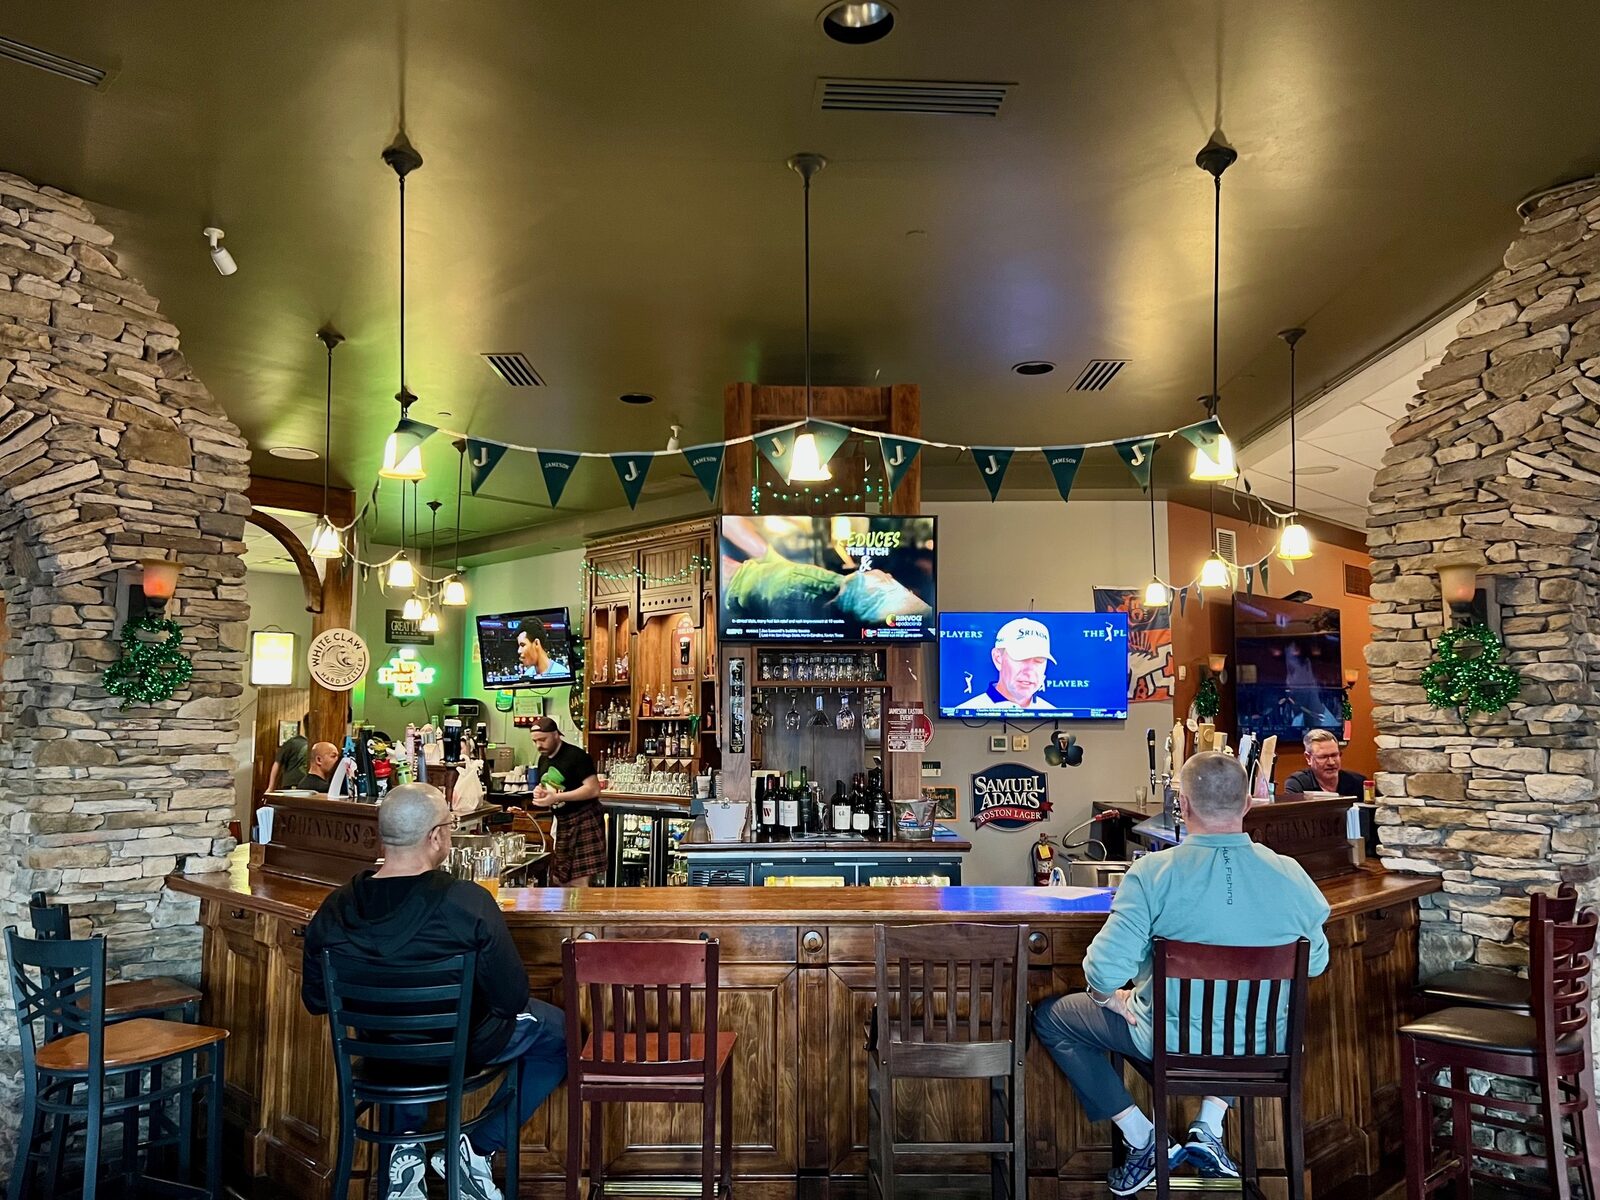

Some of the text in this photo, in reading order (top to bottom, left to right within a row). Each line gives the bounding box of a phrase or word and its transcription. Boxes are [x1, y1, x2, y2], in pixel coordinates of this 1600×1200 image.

[473, 447, 489, 467] J
[771, 437, 786, 458] J
[889, 445, 904, 466] J
[1131, 445, 1146, 466] J
[544, 462, 569, 470] JAMESON
[624, 461, 640, 481] J
[693, 456, 717, 466] JAMESON
[985, 455, 999, 475] J
[1052, 457, 1077, 466] JAMESON
[844, 531, 901, 548] EDUCES
[846, 547, 889, 557] THE ITCH
[859, 555, 873, 573] &
[391, 620, 410, 632] GREAT
[940, 630, 984, 639] PLAYERS
[1083, 629, 1105, 638] THE
[312, 632, 363, 667] WHITE CLAW
[320, 672, 341, 684] HARD
[343, 657, 363, 683] SELTZER
[1047, 680, 1090, 688] PLAYERS
[974, 775, 1046, 796] SAMUEL
[980, 791, 1041, 811] ADAMS
[978, 808, 1042, 823] BOSTON LAGER
[287, 814, 361, 845] GUINNESS
[1222, 846, 1233, 905] Huk Fishing
